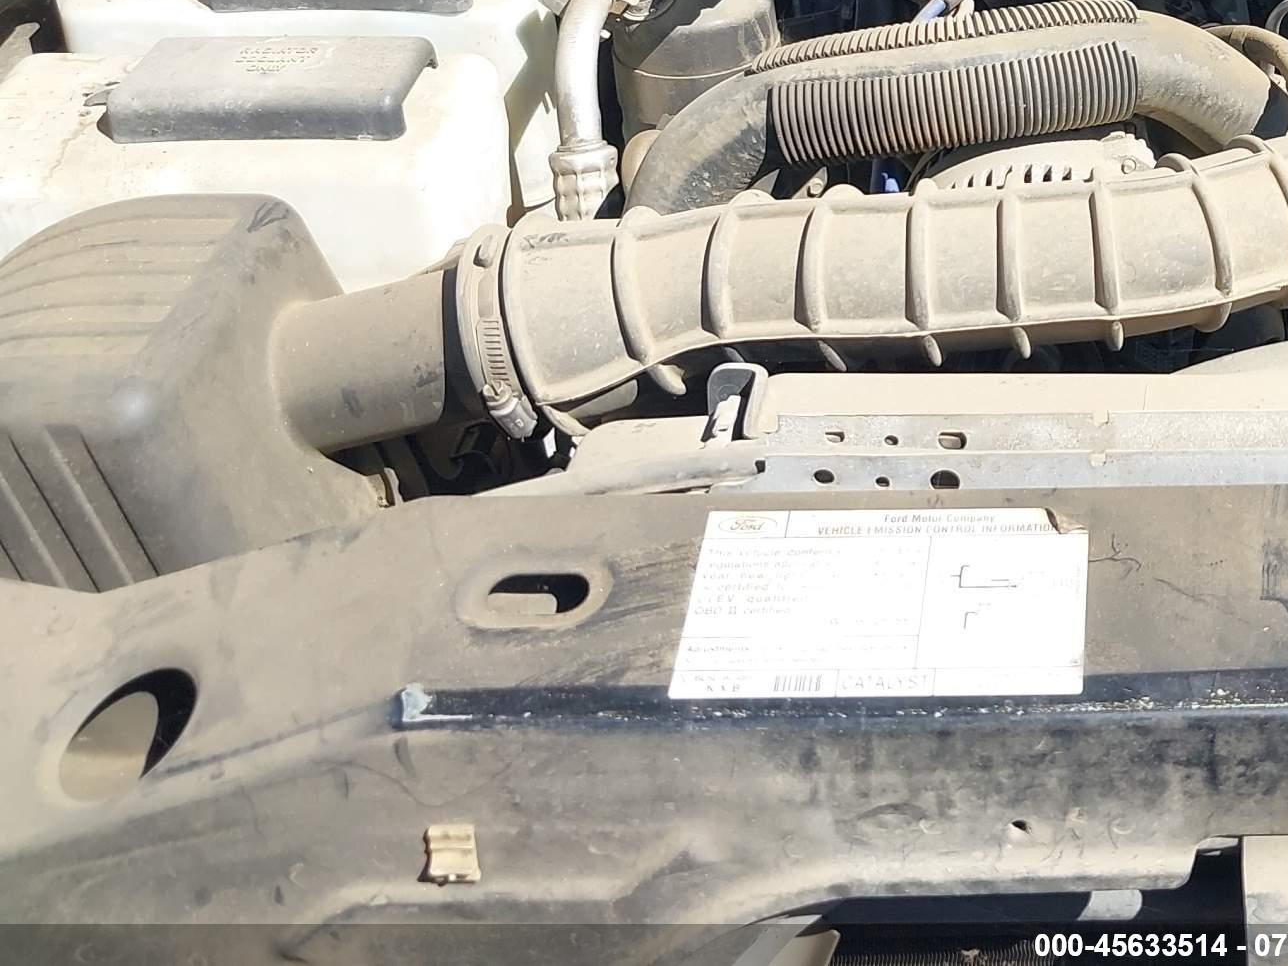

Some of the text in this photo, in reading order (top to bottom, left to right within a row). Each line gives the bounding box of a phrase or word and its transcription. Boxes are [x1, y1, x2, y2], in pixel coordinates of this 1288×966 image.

[730, 519, 766, 531] Ford
[884, 514, 996, 525] Ford Motor Company
[818, 525, 863, 536] VEHICLE
[867, 525, 922, 535] EMISSION
[926, 524, 978, 535] CONTROL
